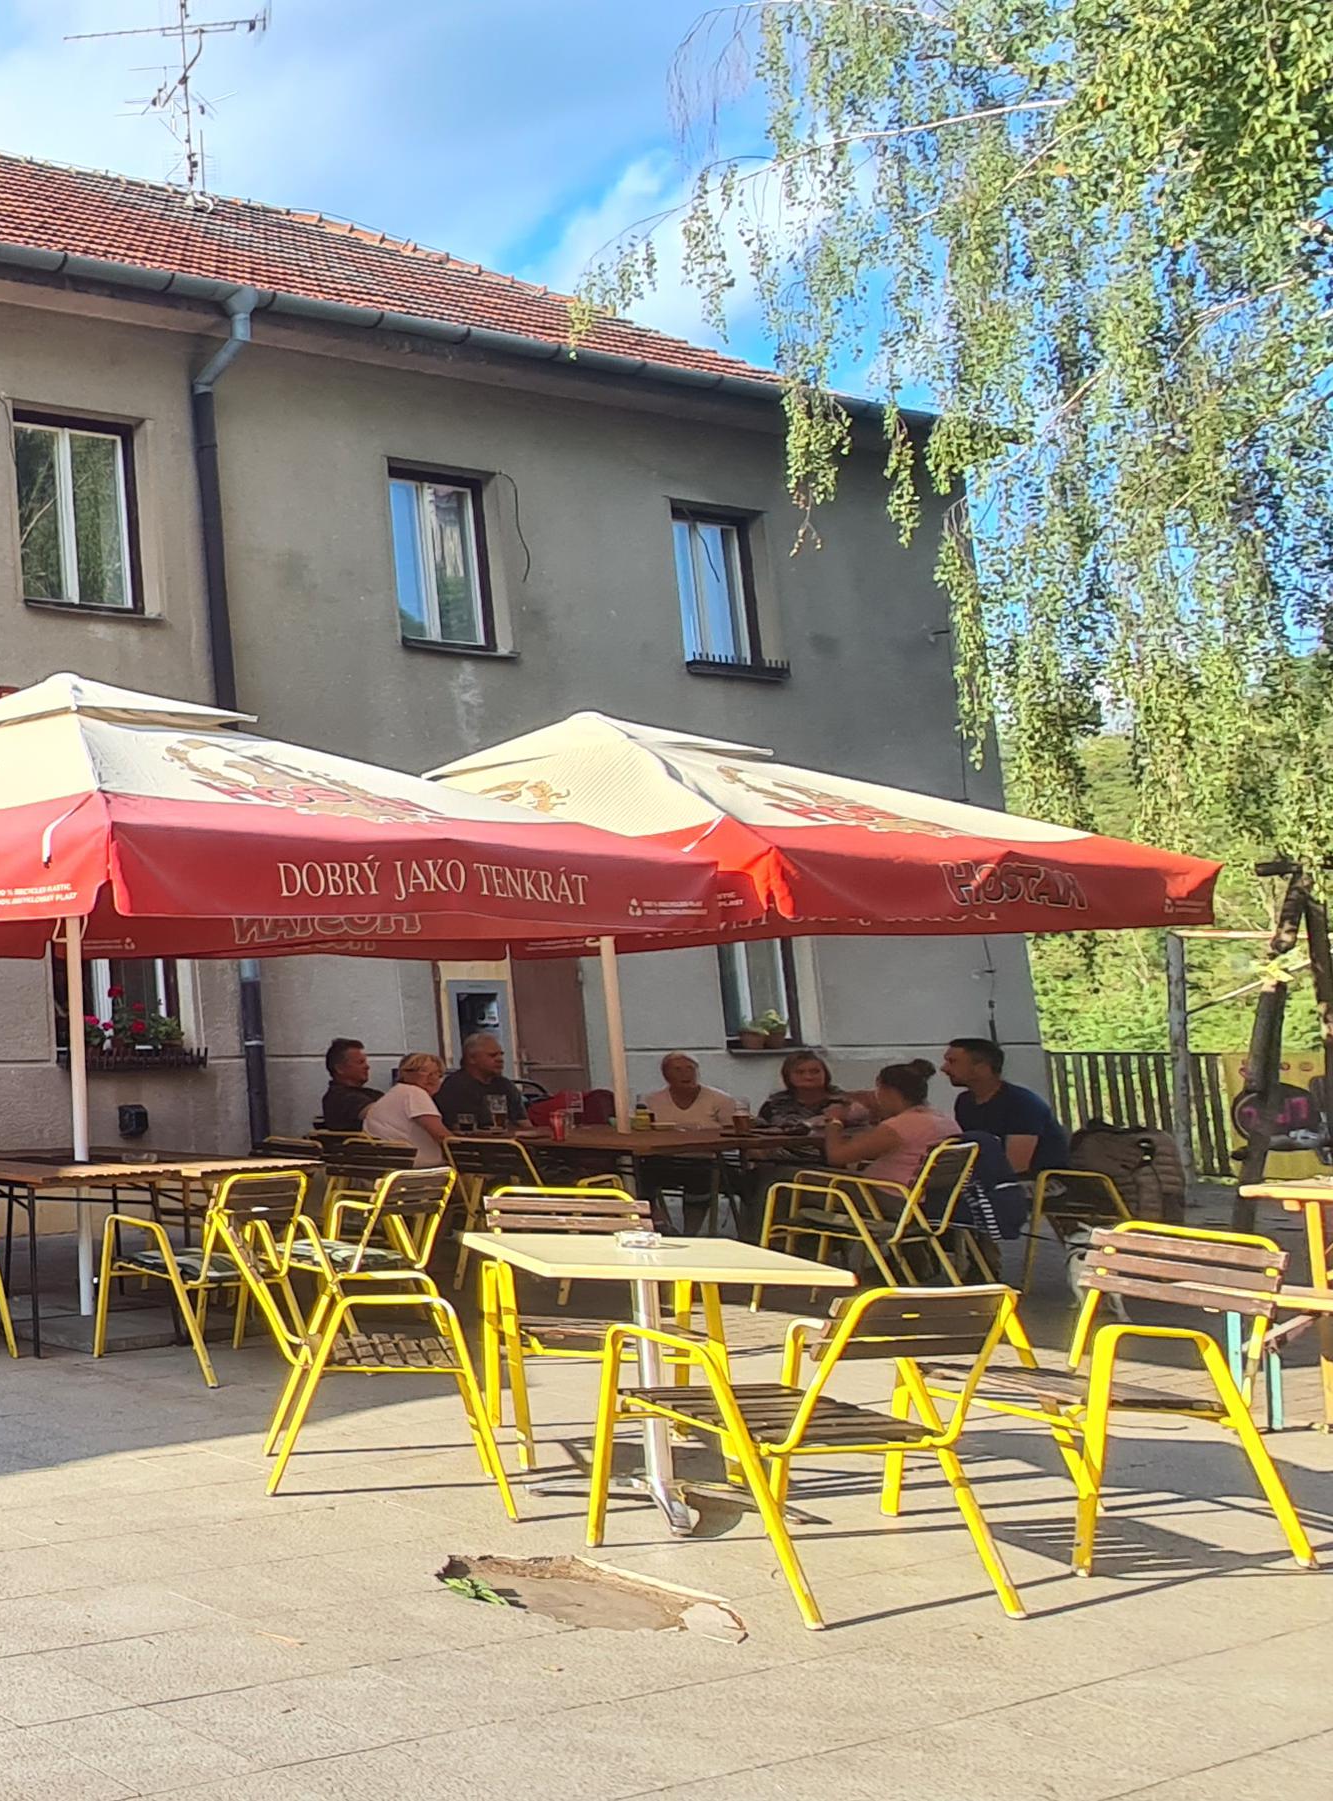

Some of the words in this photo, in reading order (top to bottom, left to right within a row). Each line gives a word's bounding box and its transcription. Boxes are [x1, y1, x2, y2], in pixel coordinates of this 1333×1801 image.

[277, 855, 381, 898] DOBRÝ
[394, 859, 466, 901] JAKO
[473, 863, 589, 905] TENKRÁT
[939, 860, 1089, 911] HOSTAN
